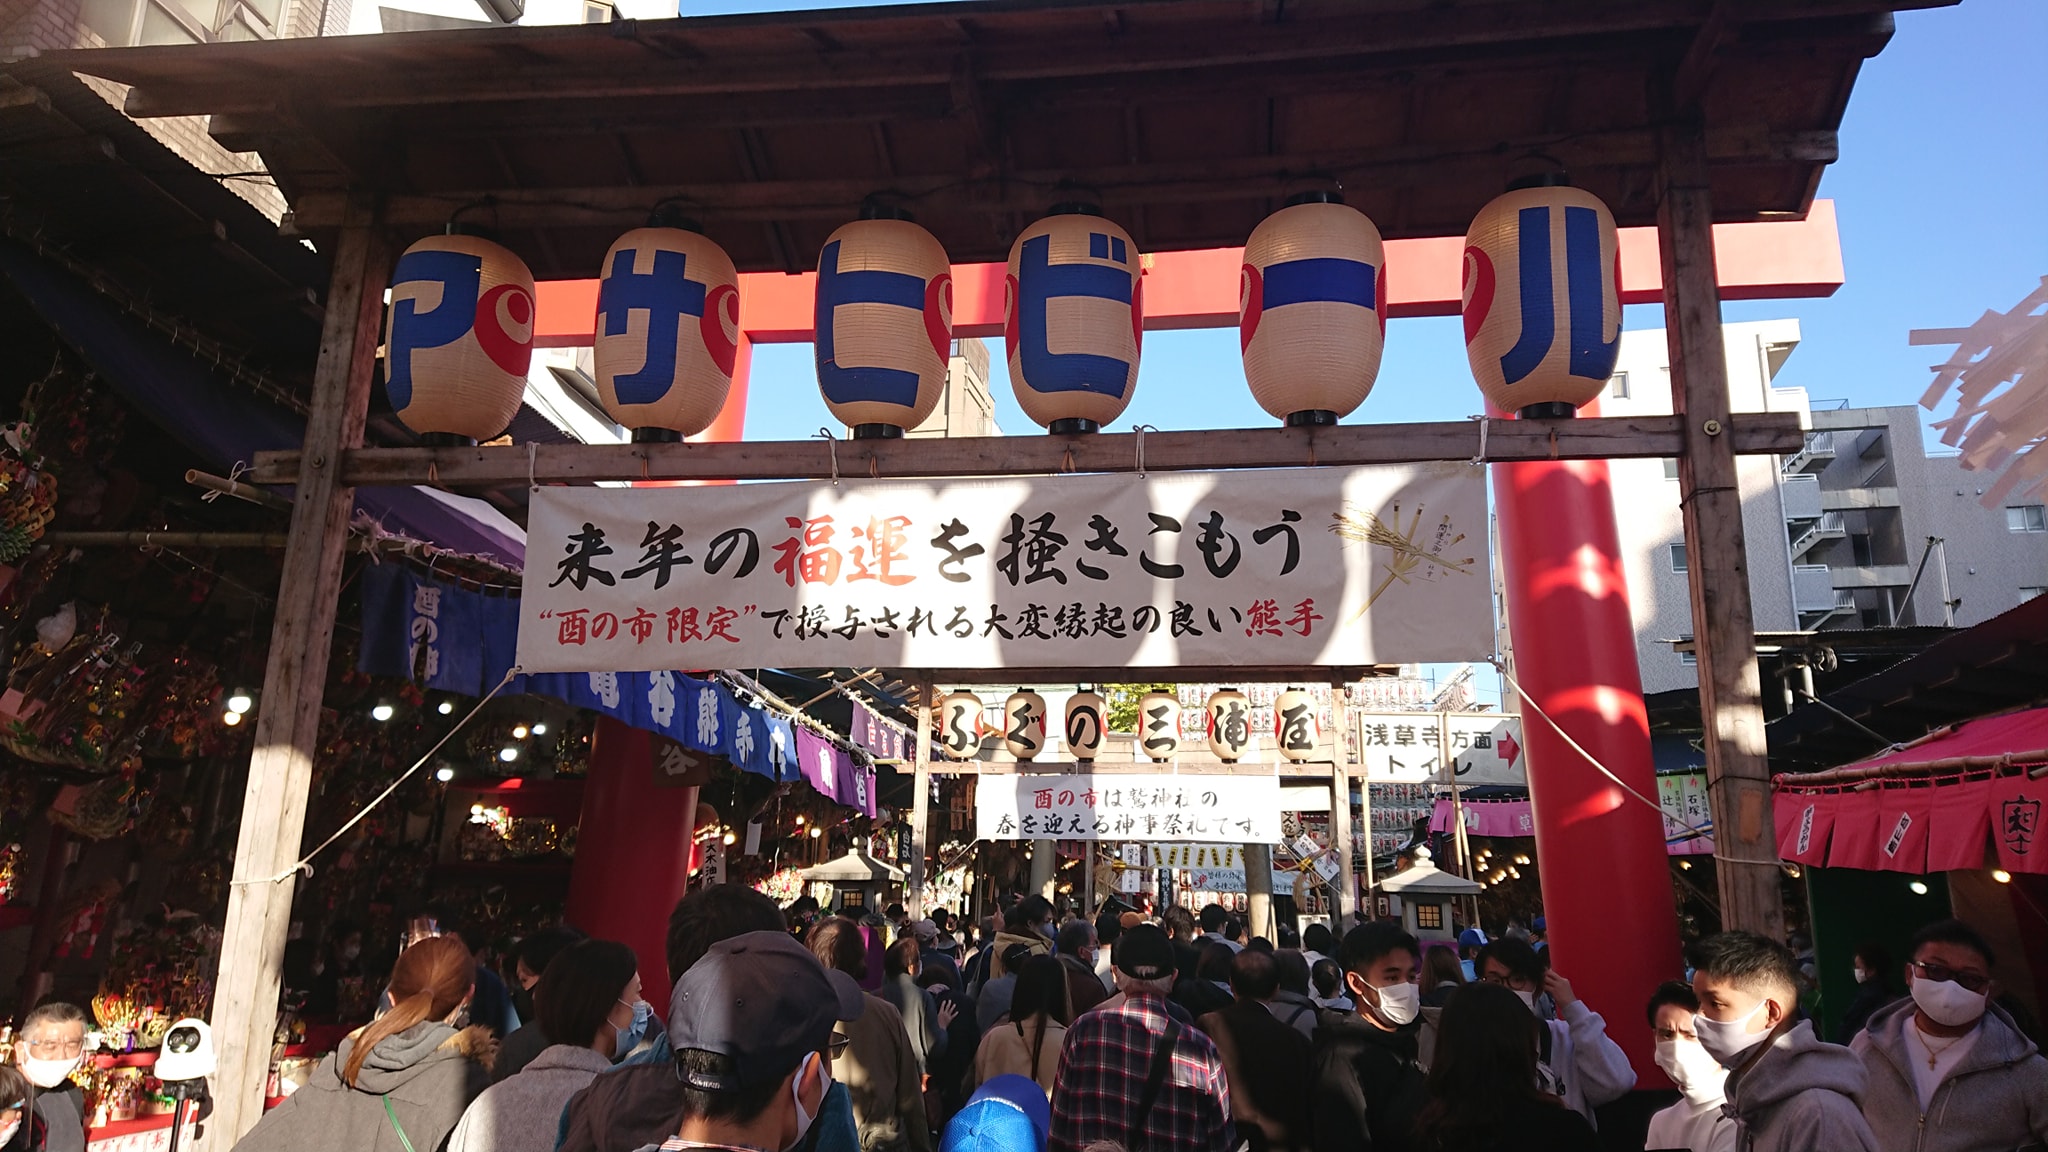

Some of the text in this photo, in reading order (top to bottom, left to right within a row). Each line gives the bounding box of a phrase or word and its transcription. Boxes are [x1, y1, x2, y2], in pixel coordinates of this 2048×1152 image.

[385, 206, 1622, 412] アサヒビール
[941, 701, 1315, 753] ふぐの三浦屋
[1365, 723, 1493, 749] 浅草寺方面
[1388, 755, 1473, 776] トイレ
